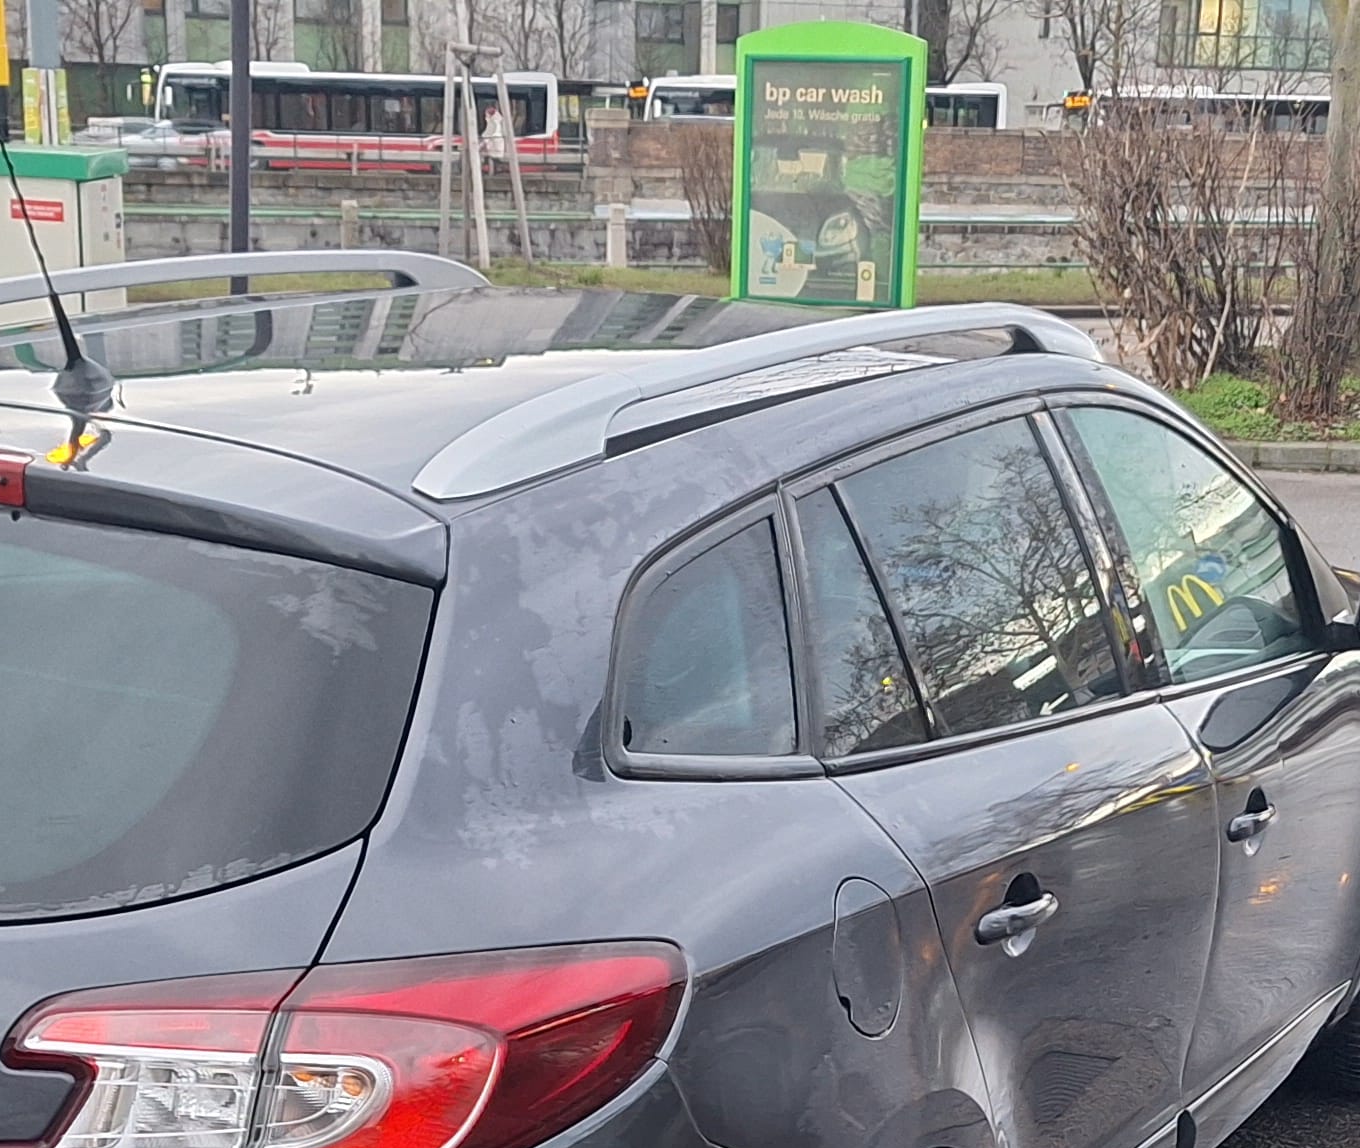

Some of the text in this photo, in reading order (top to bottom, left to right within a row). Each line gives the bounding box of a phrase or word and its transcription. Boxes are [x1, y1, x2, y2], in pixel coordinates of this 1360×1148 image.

[765, 81, 883, 106] bp car wash
